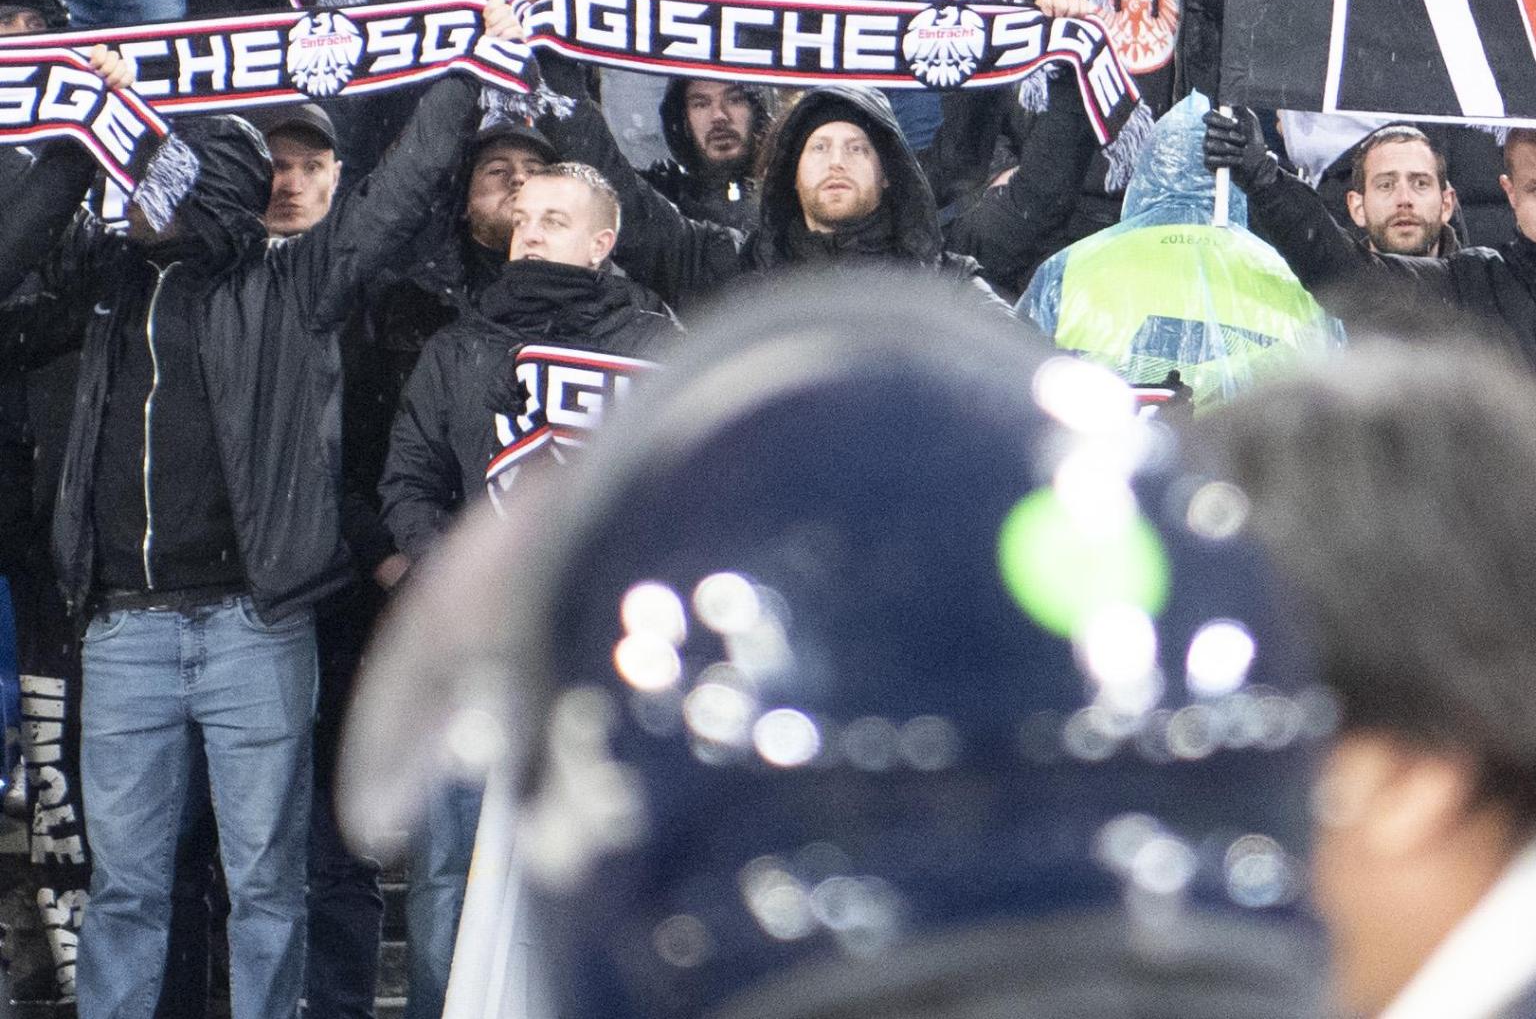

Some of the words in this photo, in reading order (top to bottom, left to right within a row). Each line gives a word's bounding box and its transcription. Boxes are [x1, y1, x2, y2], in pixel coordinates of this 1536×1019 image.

[300, 34, 353, 48] Eintracht
[366, 10, 532, 77] SGE
[917, 26, 976, 40] Eintracht
[993, 8, 1129, 110] SGE
